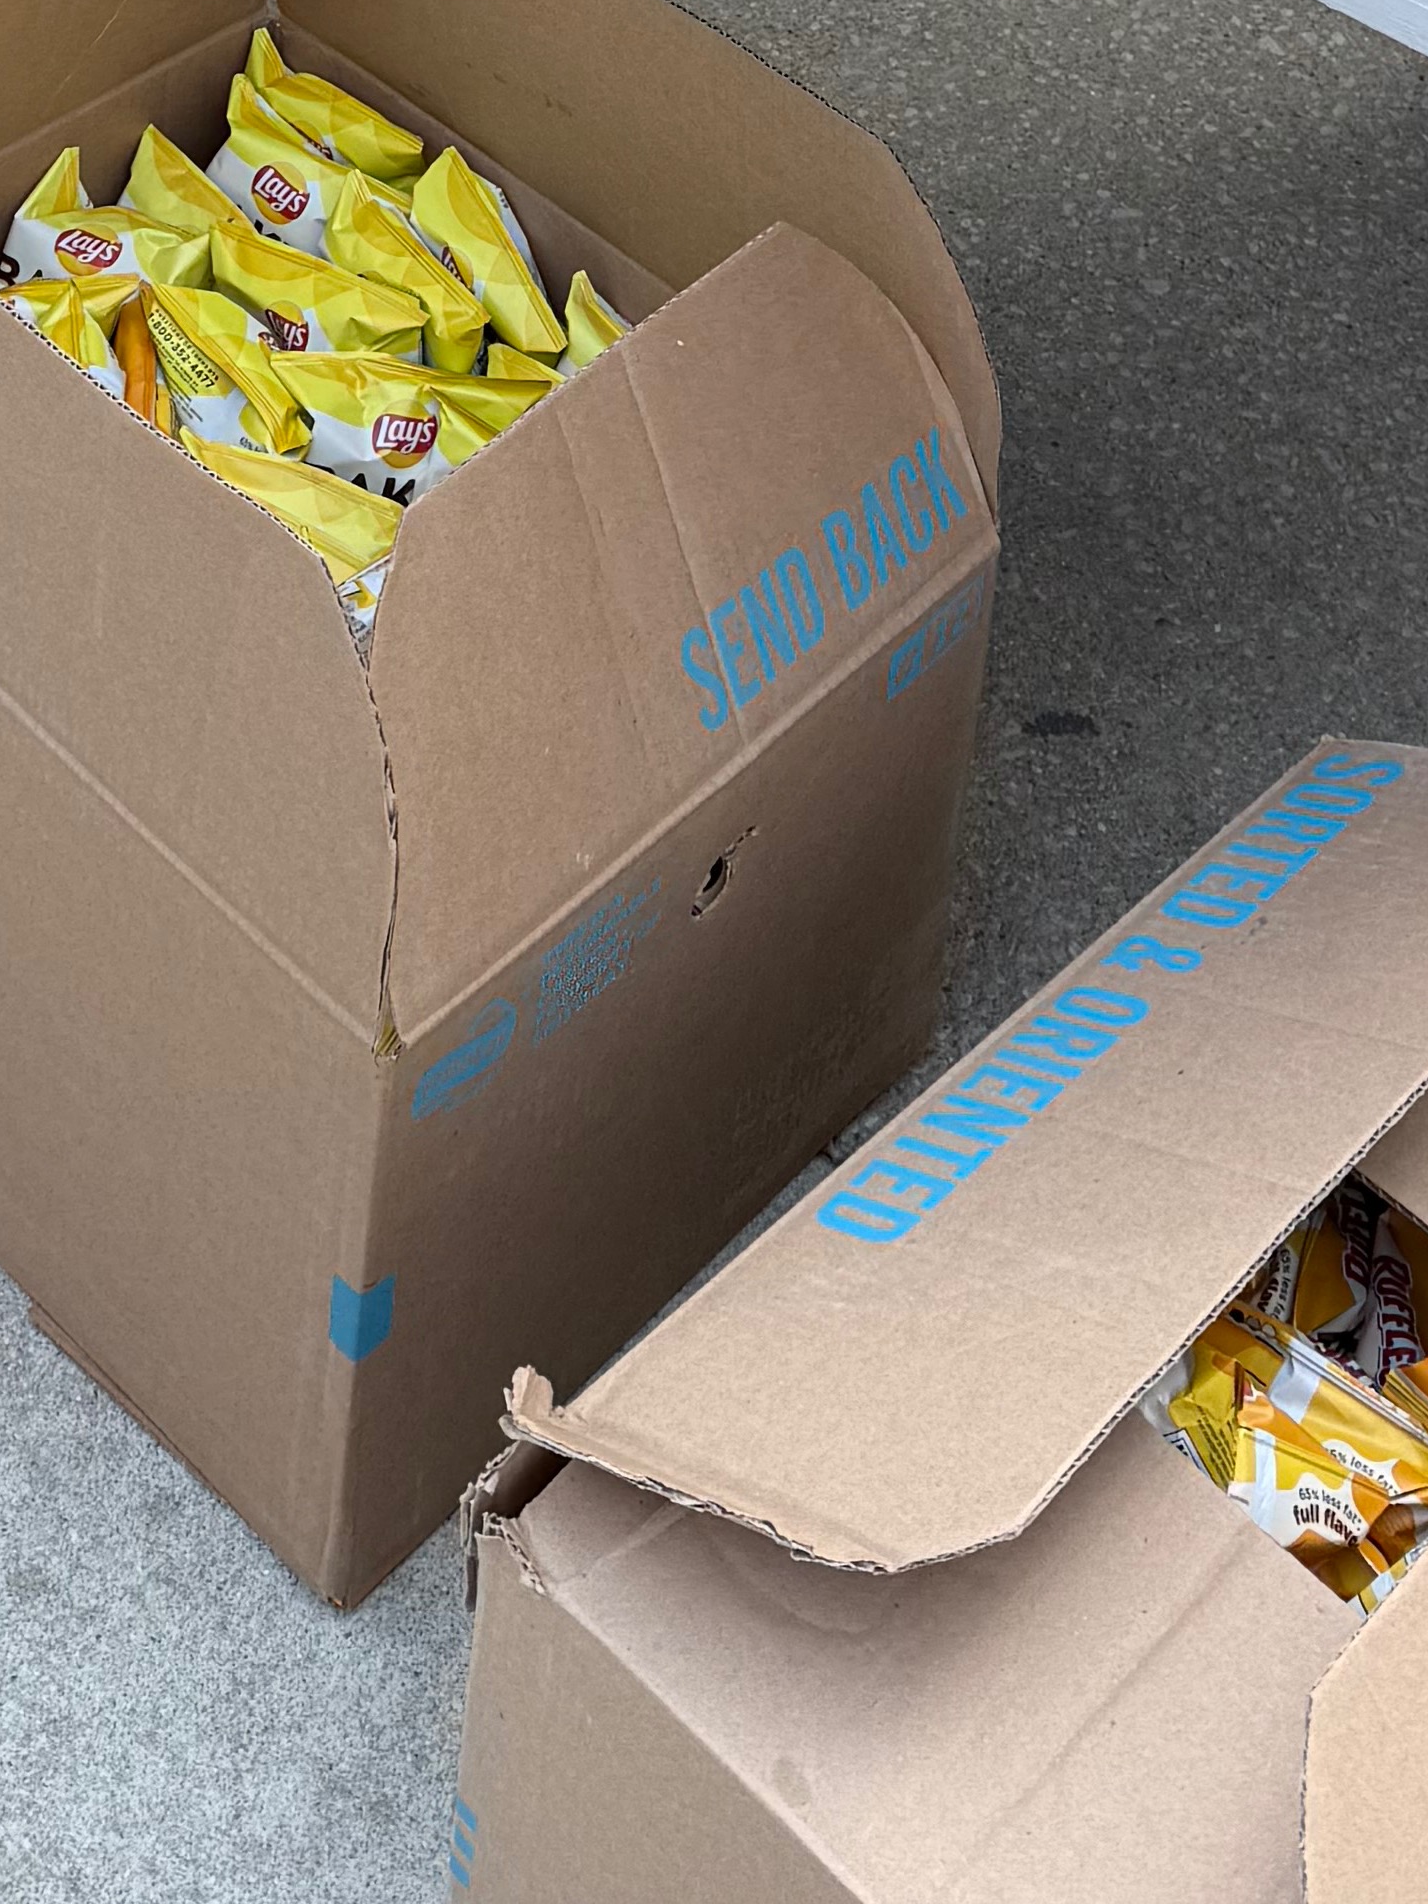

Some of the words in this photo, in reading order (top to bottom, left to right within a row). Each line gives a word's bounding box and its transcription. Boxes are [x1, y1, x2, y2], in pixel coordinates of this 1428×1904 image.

[254, 167, 307, 213] Lay's
[57, 229, 120, 262] Lay's
[377, 415, 435, 455] Lay's
[680, 545, 825, 733] SEND
[821, 424, 968, 613] BACK
[1162, 750, 1405, 929] SORTED
[1102, 933, 1204, 977] &
[814, 985, 1152, 1245] ORIENTED
[1293, 1504, 1320, 1527] full
